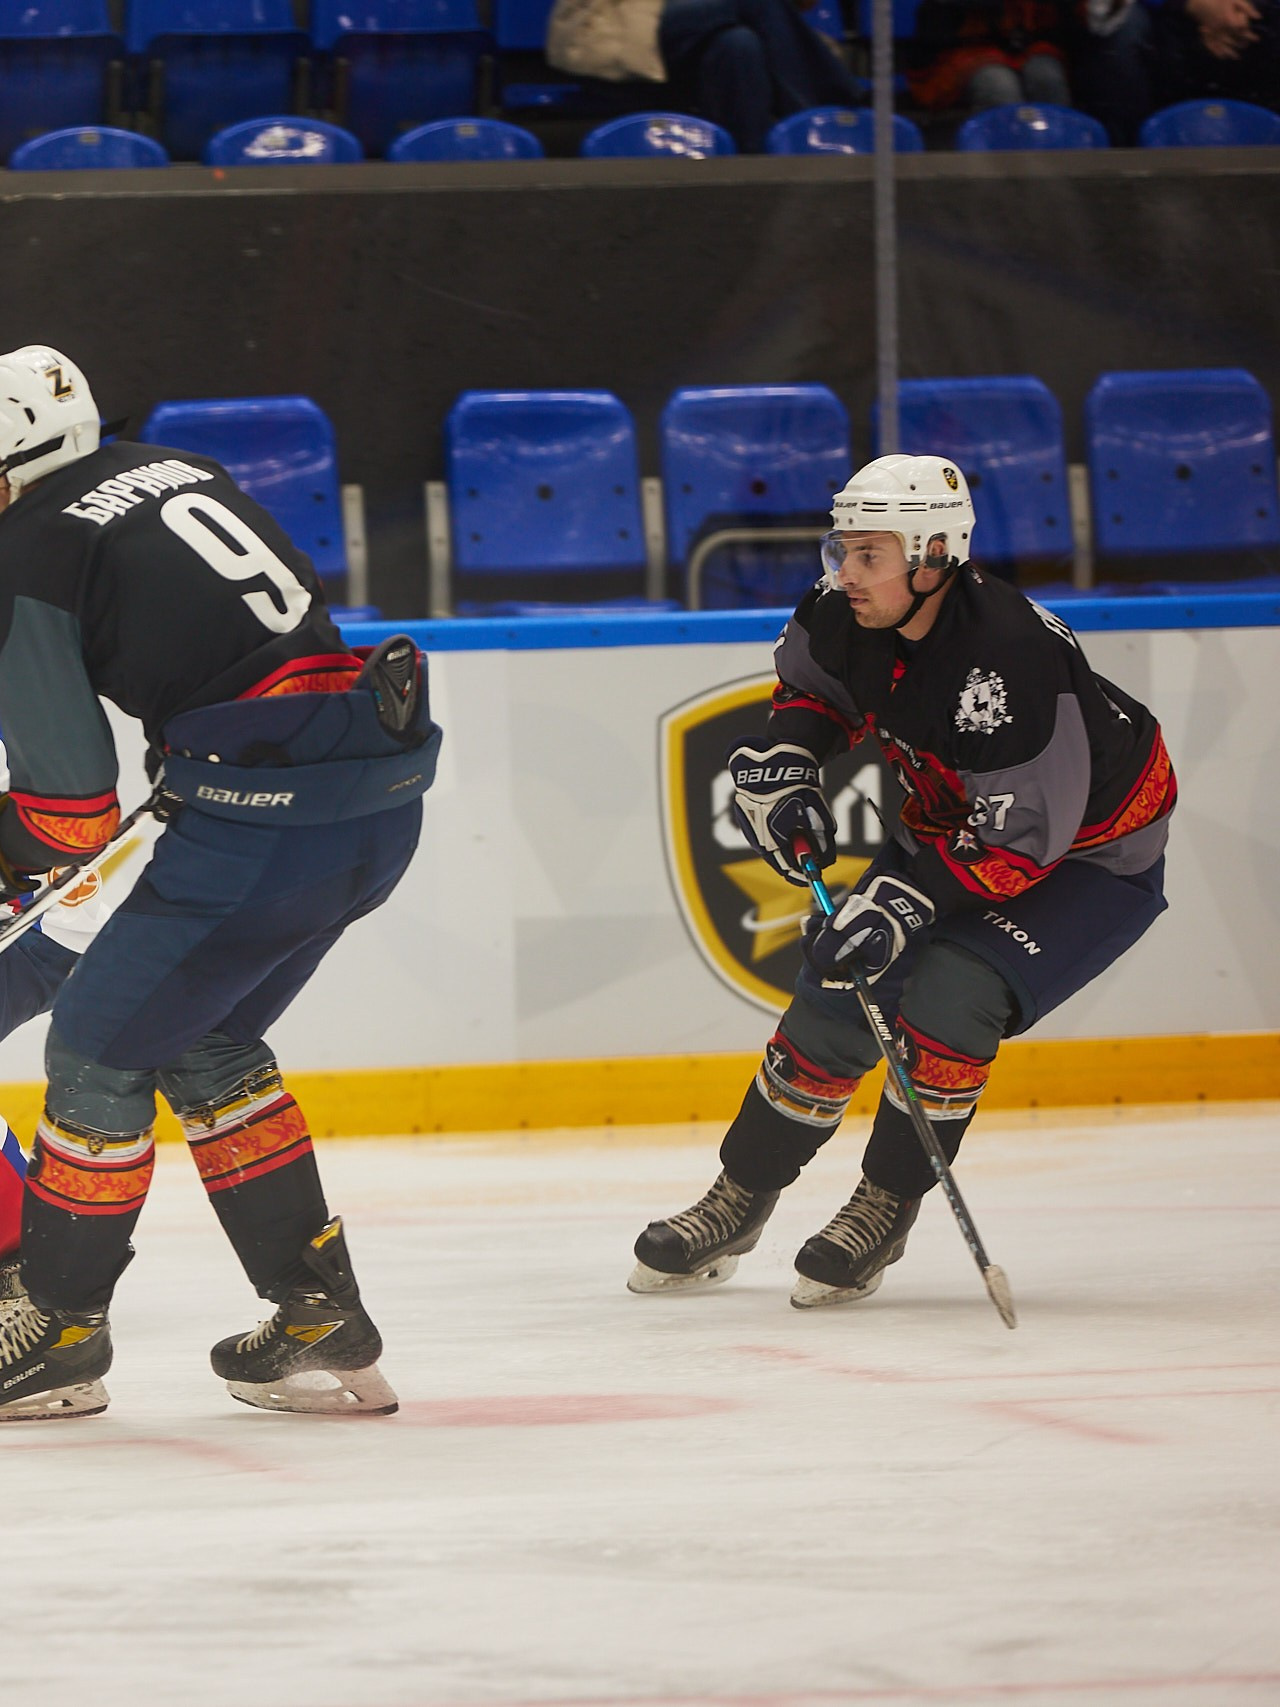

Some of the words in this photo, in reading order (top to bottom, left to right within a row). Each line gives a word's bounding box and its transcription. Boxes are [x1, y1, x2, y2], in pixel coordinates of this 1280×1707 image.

[61, 459, 215, 526] БАРАНОВ
[929, 501, 963, 510] BAUER
[160, 492, 312, 634] 9
[736, 766, 818, 785] BAUER
[196, 785, 295, 806] BAUER
[982, 910, 1042, 956] TIXON
[3, 1362, 46, 1390] BAUER
